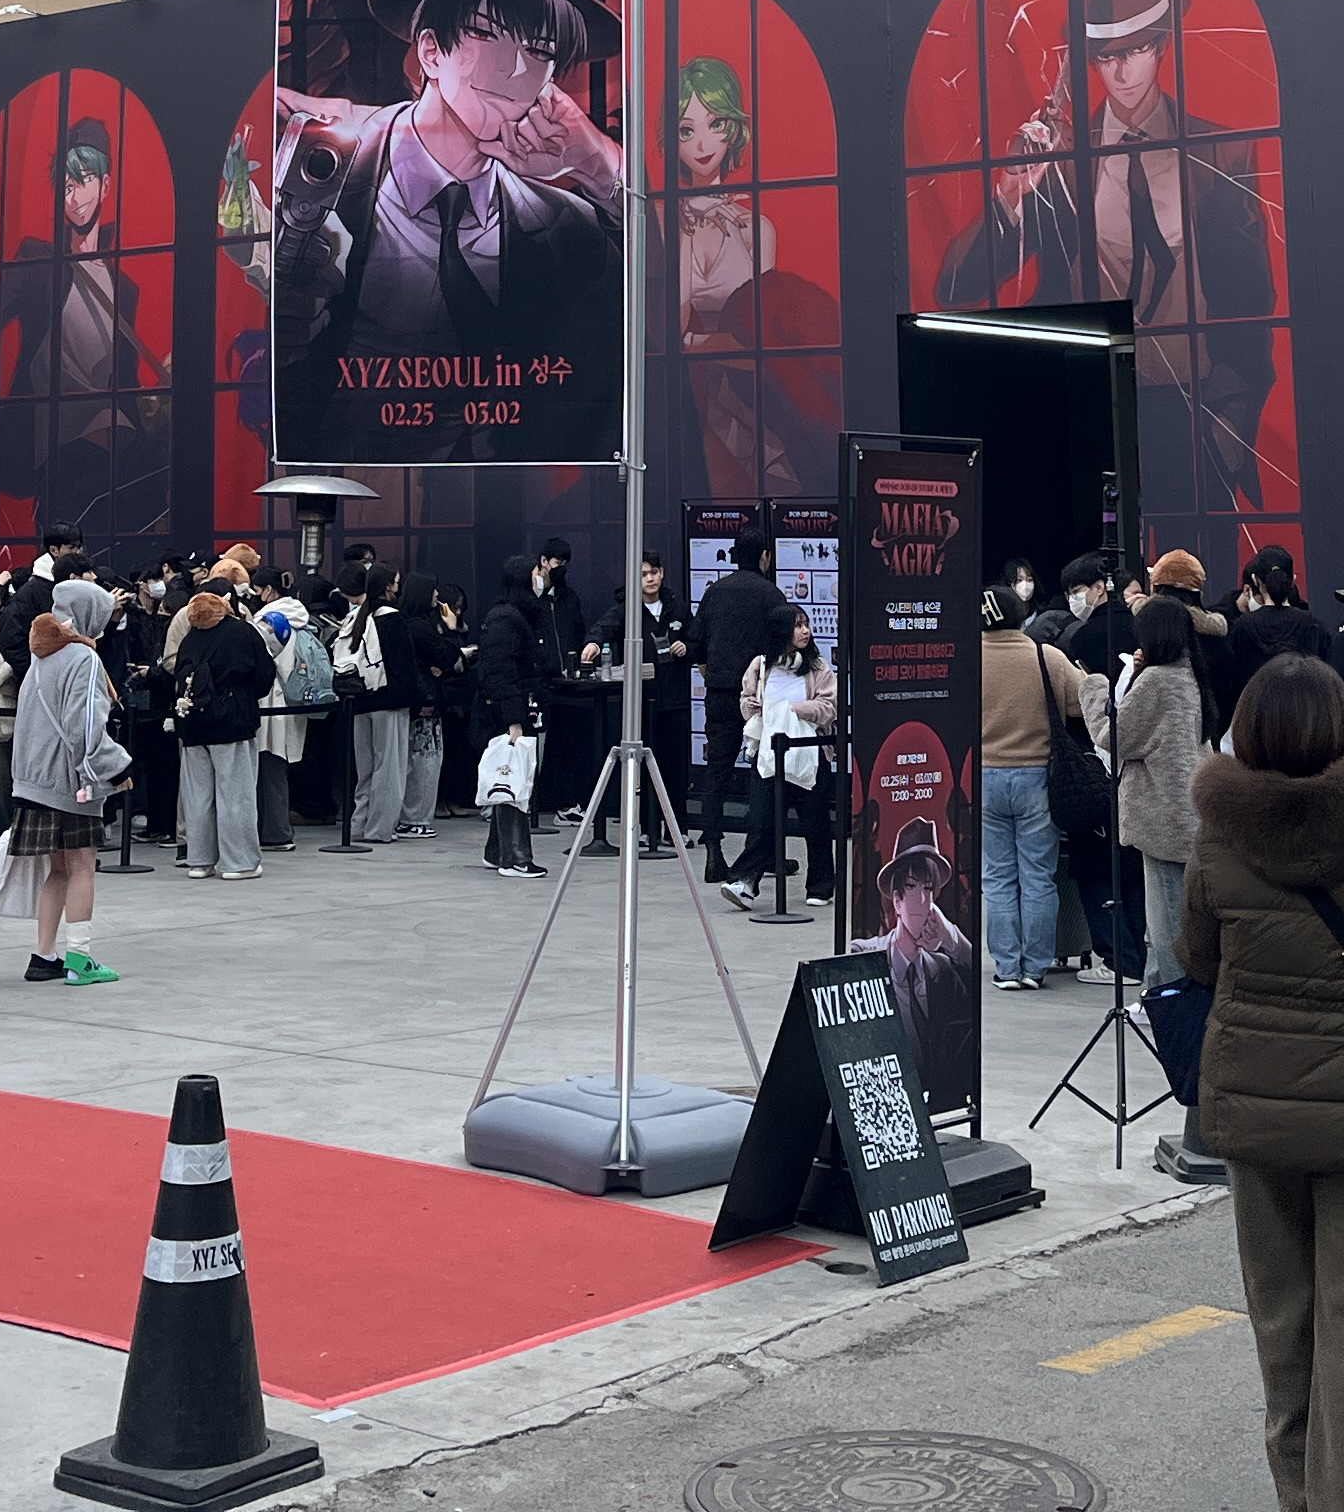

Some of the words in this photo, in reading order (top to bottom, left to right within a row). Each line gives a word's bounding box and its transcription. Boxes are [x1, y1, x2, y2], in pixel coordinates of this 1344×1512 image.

[337, 357, 392, 388] XYZ
[398, 356, 490, 388] SEOUL
[495, 354, 522, 386] in
[528, 355, 574, 385] 성수
[380, 402, 434, 426] 02.25
[464, 401, 521, 425] 03.02
[881, 502, 945, 537] MAFIA
[889, 543, 937, 576] AGIT
[811, 985, 846, 1028] XYZ
[844, 978, 895, 1022] SEOUL
[869, 1205, 895, 1246] NO
[893, 1193, 955, 1240] PARKING!
[192, 1246, 218, 1272] XYZ
